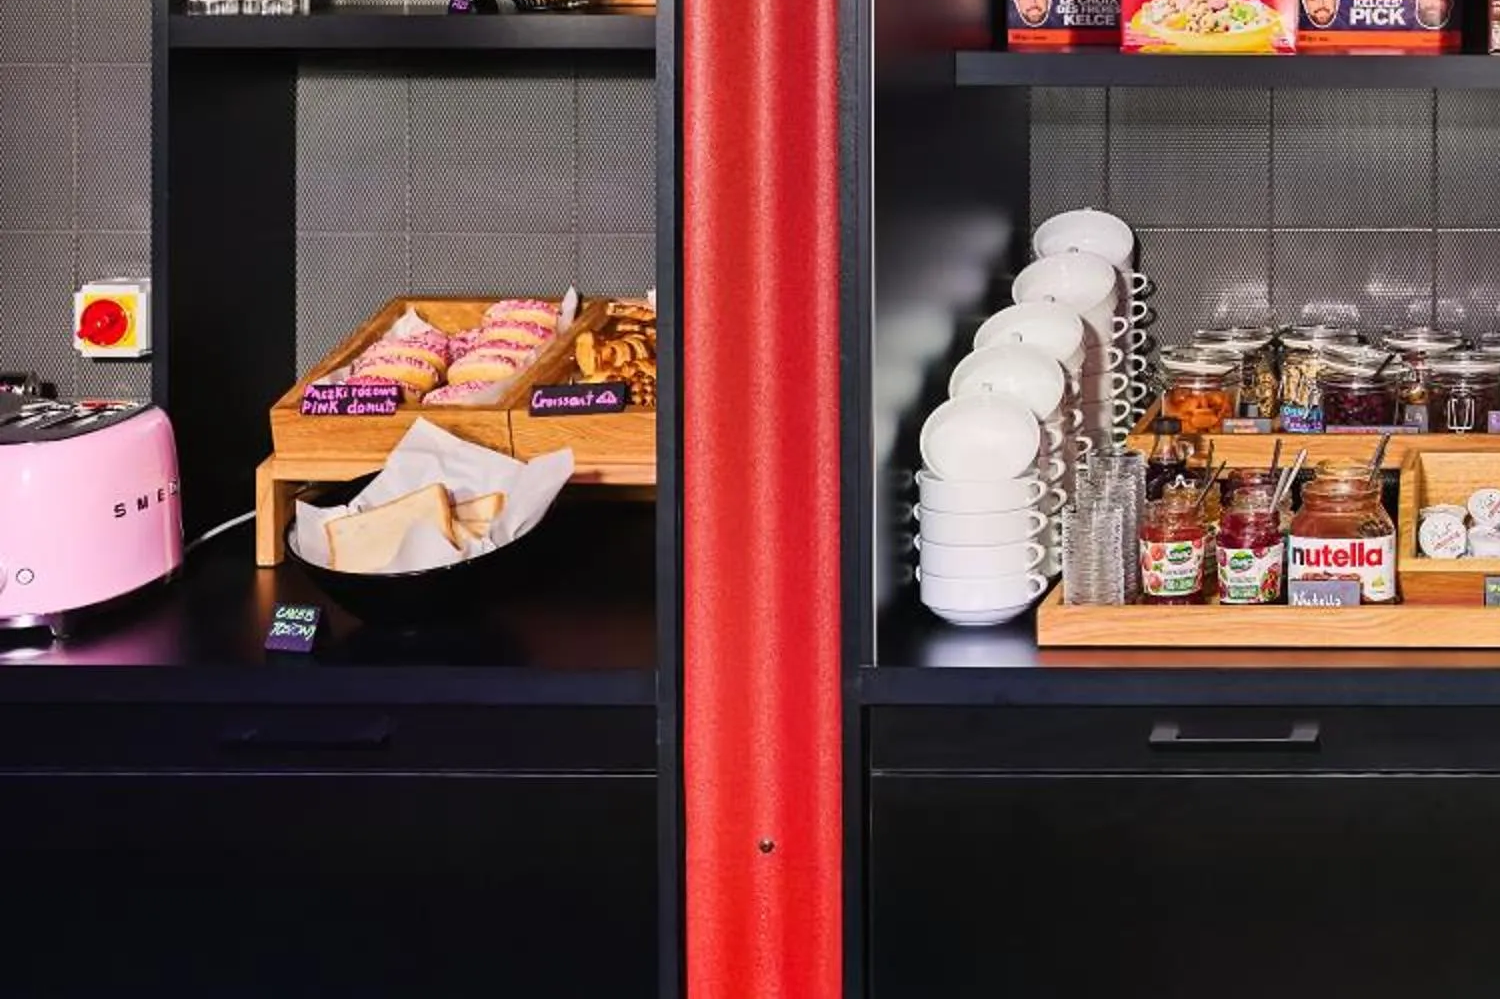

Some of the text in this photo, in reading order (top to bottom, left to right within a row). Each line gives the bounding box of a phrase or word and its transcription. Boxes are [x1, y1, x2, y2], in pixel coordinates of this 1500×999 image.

[1063, 14, 1117, 26] KELCE
[1350, 8, 1406, 25] PICK
[1292, 542, 1383, 567] nutella
